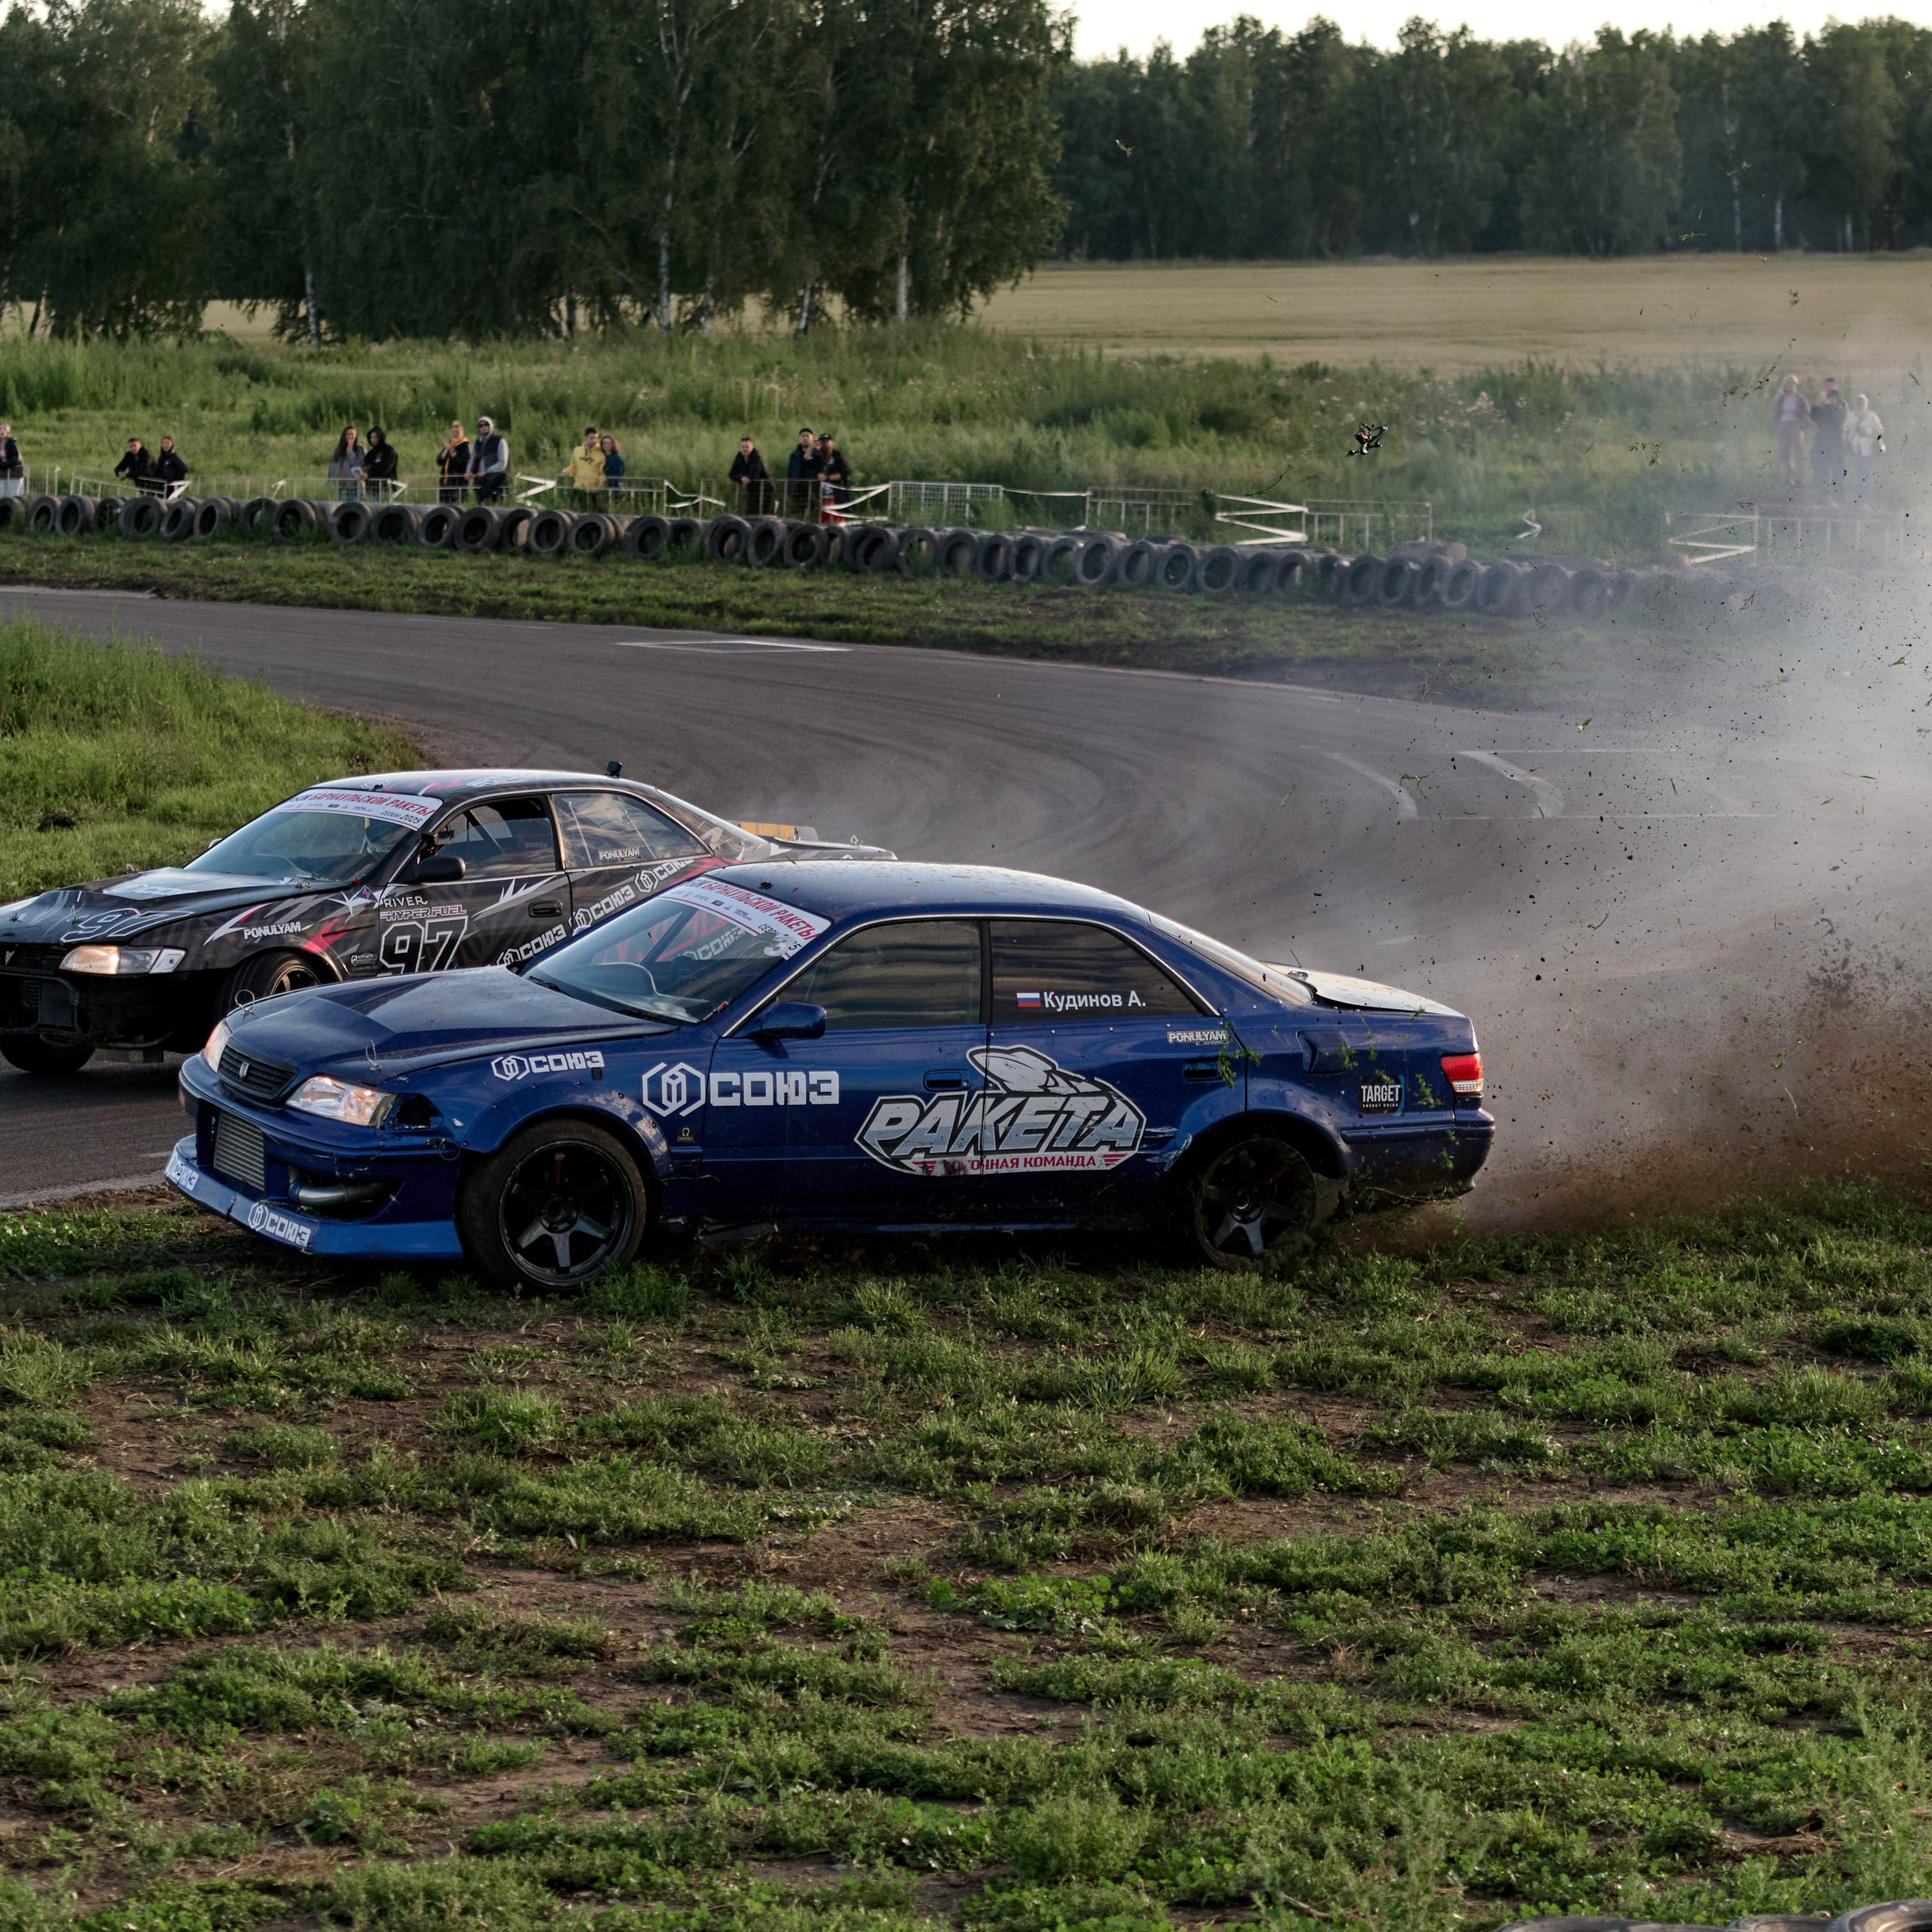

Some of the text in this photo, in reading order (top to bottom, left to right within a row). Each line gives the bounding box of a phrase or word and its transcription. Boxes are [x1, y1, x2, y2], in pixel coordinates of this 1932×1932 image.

[385, 799, 435, 816] РАКЕТЫ
[399, 814, 423, 824] 2025
[598, 848, 640, 860] PONULYAM
[383, 896, 428, 908] RIVER
[590, 884, 635, 921] СОЮЗ
[700, 881, 783, 913] БАРНАУЛЬСКОЙ
[774, 907, 822, 940] РАКЕТЫ
[60, 908, 195, 943] 97
[244, 921, 301, 940] PONULYAM
[379, 915, 469, 974] 97
[520, 923, 567, 959] СОЮЗ
[1043, 990, 1146, 1012] Кудинов А.
[1168, 1030, 1226, 1043] PONULYAM
[528, 1051, 605, 1073] СОЮЗ
[709, 1070, 839, 1106] СОЮЗ
[1361, 1084, 1401, 1103] TARGET
[863, 1096, 1138, 1155] РАКЕТА
[1023, 1155, 1097, 1168] КОМАНДА
[265, 1212, 312, 1247] СОЮЗ
